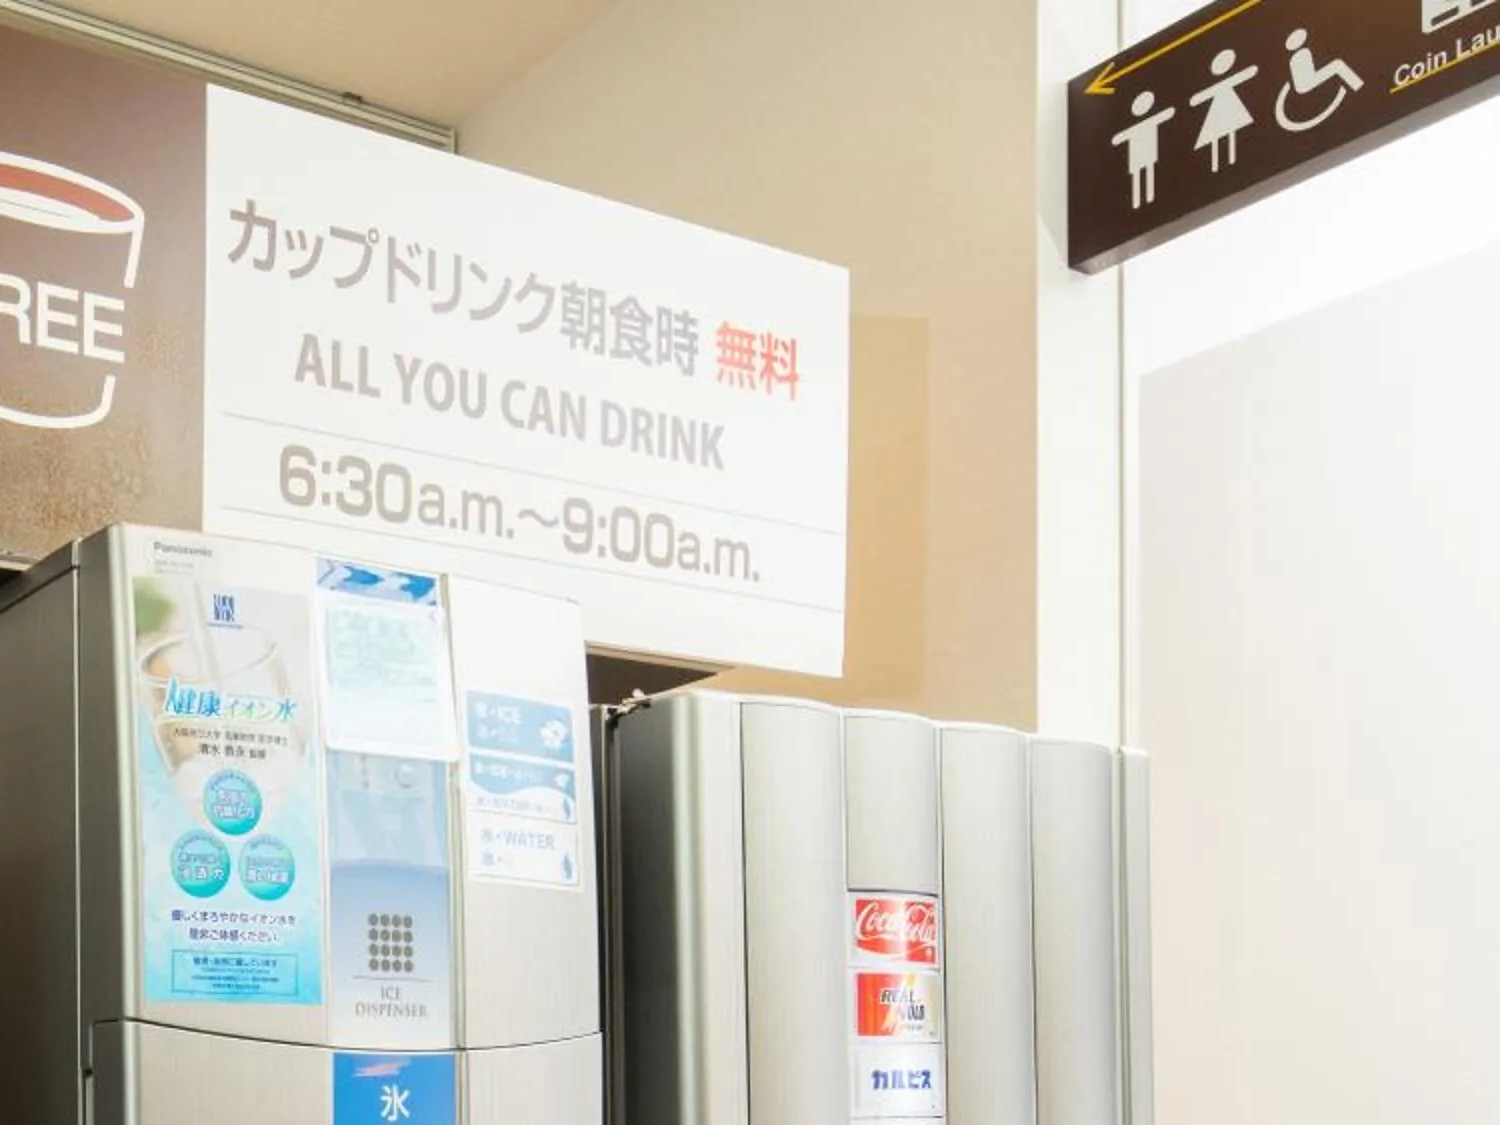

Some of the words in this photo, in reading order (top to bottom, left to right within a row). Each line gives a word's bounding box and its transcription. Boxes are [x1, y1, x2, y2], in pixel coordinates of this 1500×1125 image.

[1394, 51, 1447, 86] Coin
[227, 199, 700, 377] カップドリンク朝食時
[713, 320, 800, 401] 無料
[294, 333, 383, 398] ALL
[393, 354, 488, 421] YOU
[498, 378, 587, 444] CAN
[599, 400, 726, 471] DRINK
[355, 1001, 428, 1020] DISPENSER
[380, 985, 403, 1002] ICE
[380, 1084, 411, 1121] 氷
